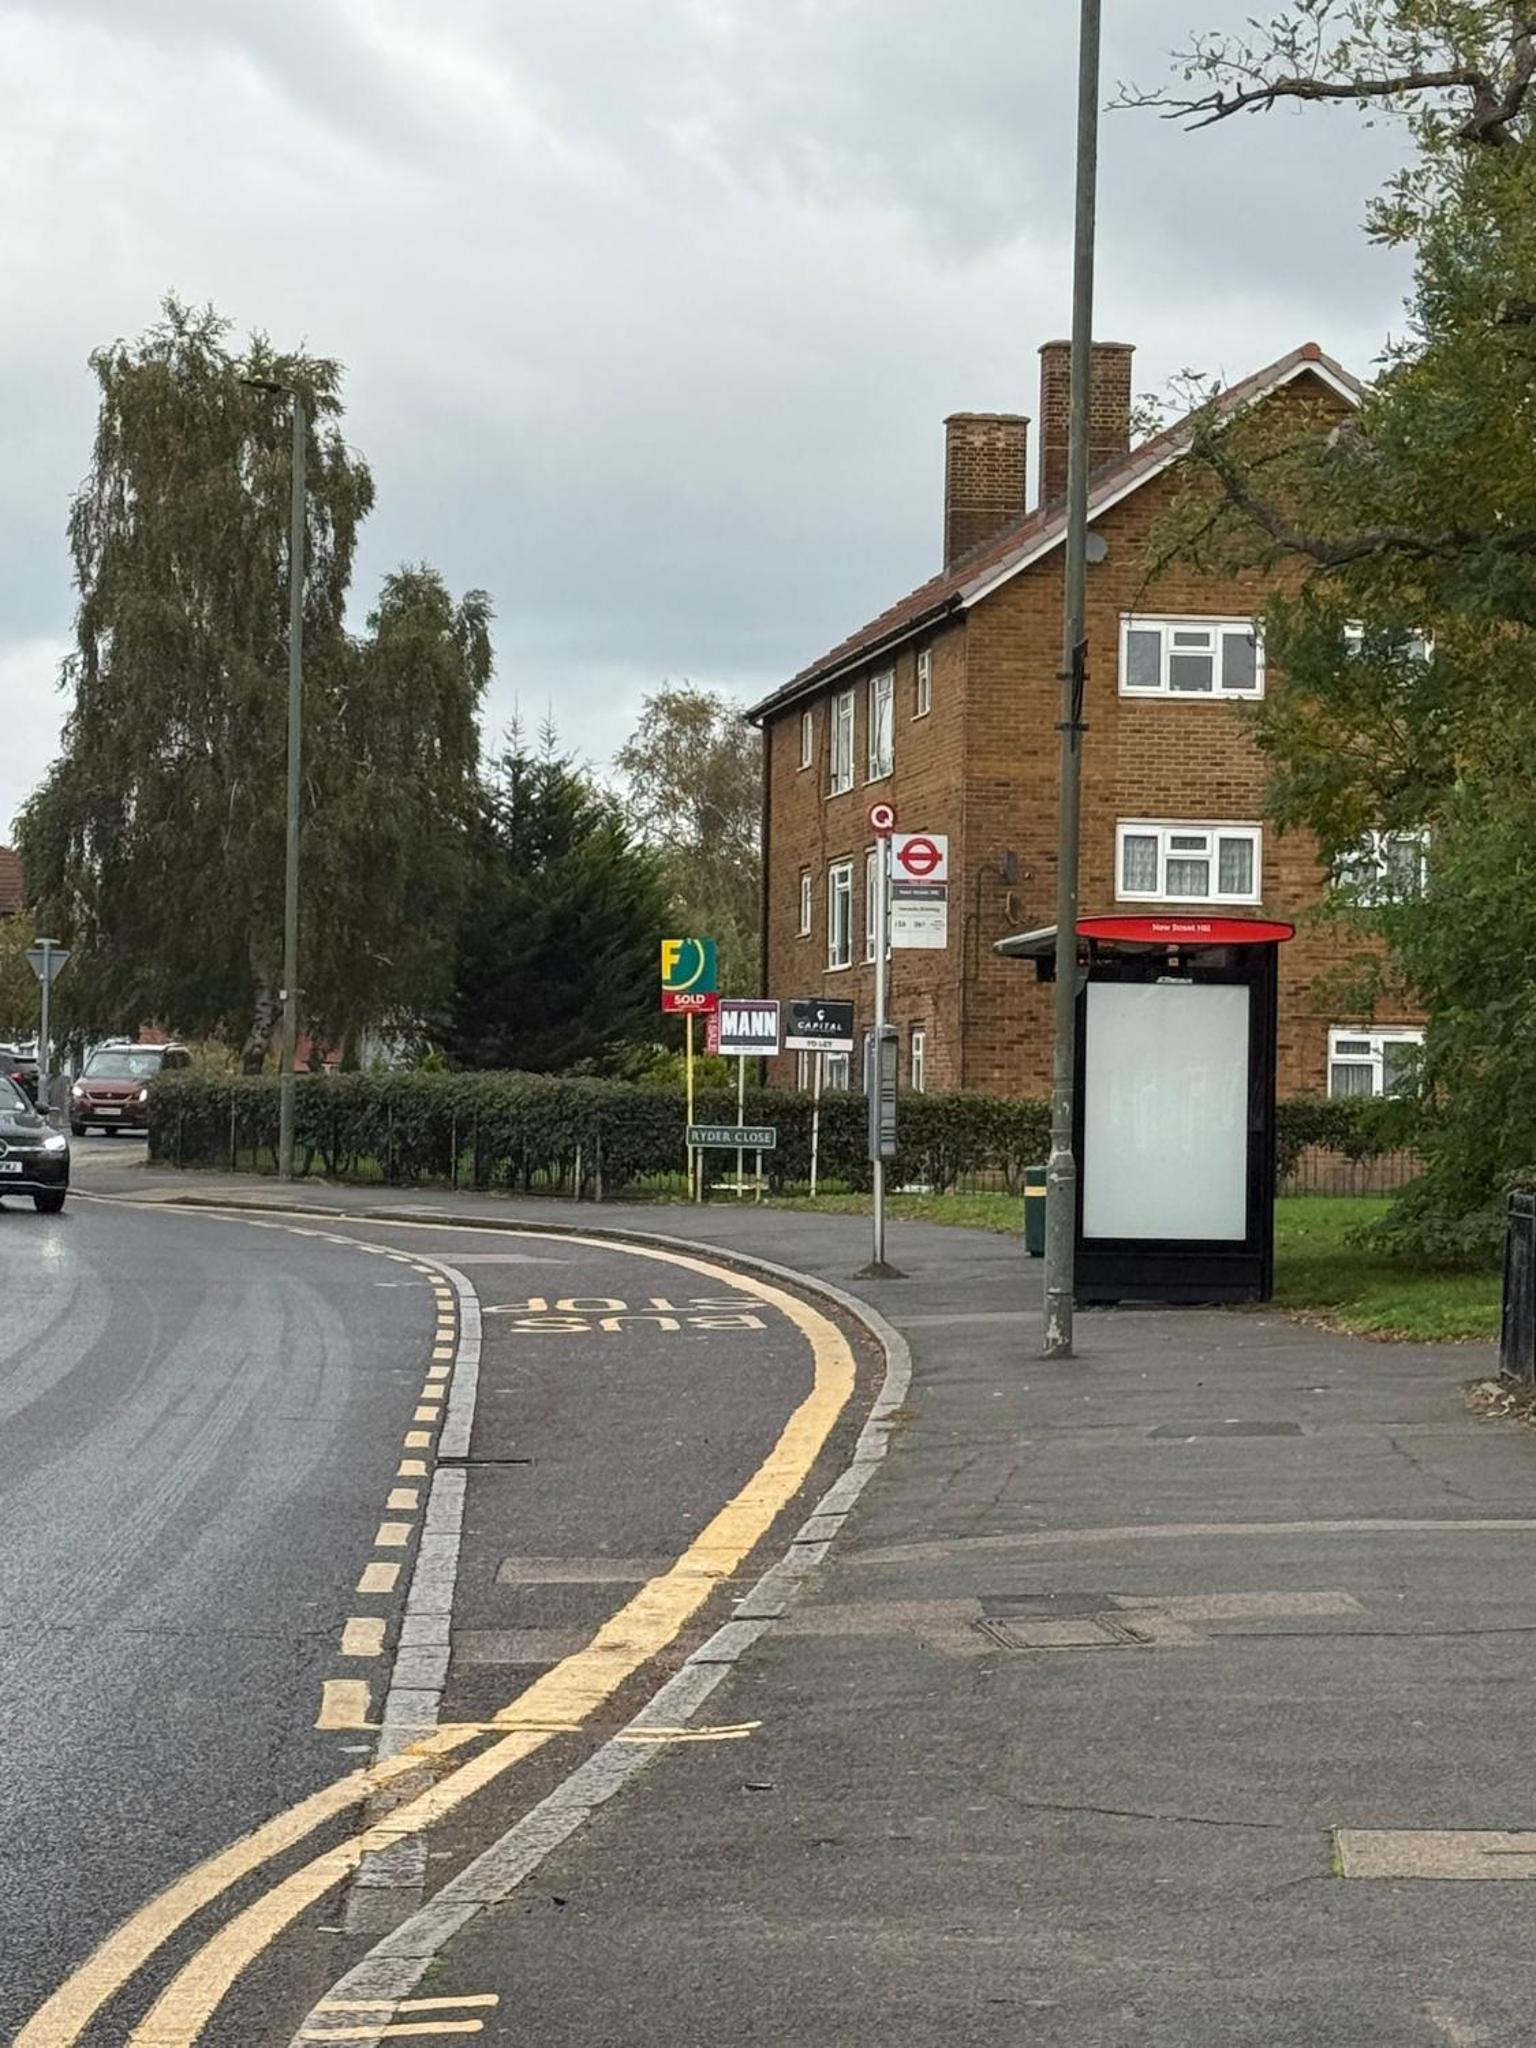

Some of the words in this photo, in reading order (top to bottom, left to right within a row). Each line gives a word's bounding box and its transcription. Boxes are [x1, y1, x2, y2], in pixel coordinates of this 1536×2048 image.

[674, 994, 706, 1005] SOLD
[721, 1011, 777, 1037] MANN
[797, 1020, 843, 1032] CAPITAL
[807, 1040, 817, 1048] TO
[818, 1040, 833, 1048] LET
[691, 1130, 731, 1142] RYDER
[734, 1132, 771, 1143] CLOSE
[481, 1296, 770, 1313] STOP
[510, 1313, 769, 1334] BUS
